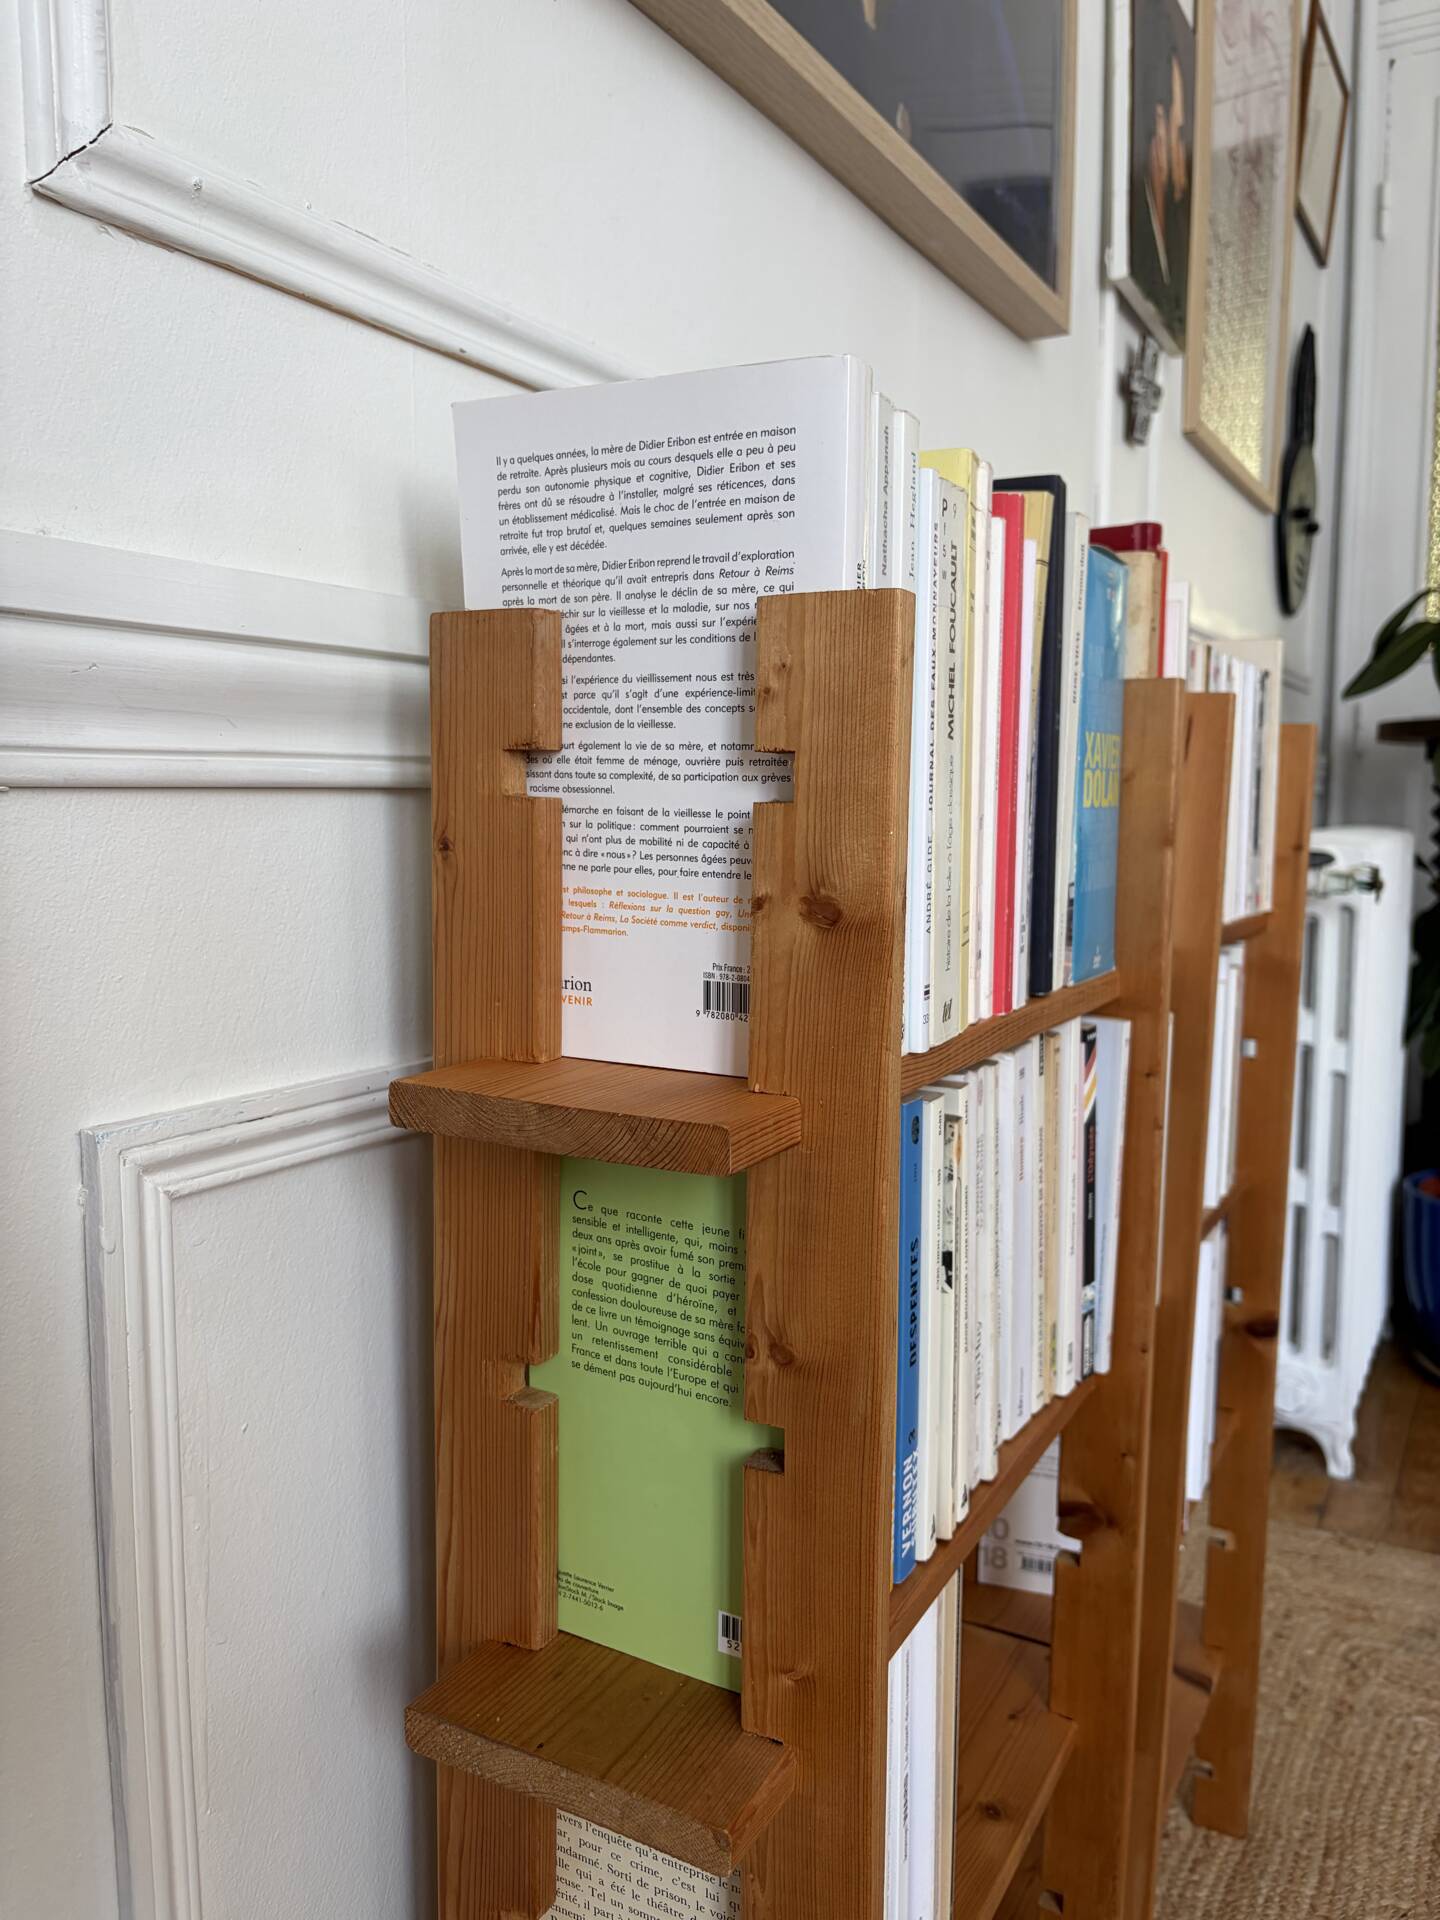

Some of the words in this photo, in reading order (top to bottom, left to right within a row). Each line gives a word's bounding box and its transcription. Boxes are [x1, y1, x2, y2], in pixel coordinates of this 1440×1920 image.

[495, 456, 501, 466] Il
[502, 458, 508, 467] y
[509, 457, 515, 465] a
[516, 452, 554, 466] quelques
[554, 448, 588, 460] années,
[590, 446, 599, 456] la
[600, 444, 623, 455] mère
[624, 441, 636, 452] de
[638, 439, 665, 451] Didier
[666, 435, 696, 448] Eribon
[697, 434, 712, 444] est
[712, 430, 744, 443] entrée
[744, 430, 758, 439] en
[760, 426, 796, 438] maison
[882, 425, 890, 495] Appanah
[497, 484, 521, 498] perdu
[525, 485, 540, 494] son
[544, 478, 590, 492] autonomie
[593, 475, 632, 489] physique
[635, 473, 644, 483] et
[648, 469, 691, 483] cognitive,
[696, 465, 724, 477] Didier
[729, 461, 760, 473] Eribon
[764, 460, 775, 470] et
[780, 460, 796, 469] ses
[499, 530, 528, 541] retraite
[531, 528, 542, 538] fut
[546, 529, 563, 539] trop
[566, 523, 591, 536] brutal
[594, 524, 604, 534] et,
[608, 521, 647, 534] quelques
[650, 517, 691, 529] semaines
[695, 512, 742, 525] seulement
[746, 509, 773, 523] après
[777, 510, 795, 519] son
[881, 500, 889, 576] Nathacha
[501, 580, 547, 594] personnelle
[550, 580, 559, 589] et
[562, 577, 601, 589] théorique
[604, 575, 622, 588] qu'il
[626, 574, 647, 584] avait
[650, 571, 688, 584] entrepris
[692, 569, 714, 580] dans
[718, 568, 750, 579] Retour
[753, 566, 760, 577] à
[764, 565, 794, 576] Reims
[949, 540, 958, 654] FOUCAULT
[948, 662, 956, 741] MICHEL
[526, 769, 552, 778] sissant
[553, 769, 573, 779] dans
[574, 770, 596, 779] toute
[597, 772, 607, 780] sa
[658, 770, 669, 781] de
[671, 773, 681, 781] sa
[741, 774, 758, 782] aux
[760, 772, 791, 784] grèves
[562, 976, 592, 992] rion
[571, 1215, 607, 1229] sensible
[612, 1223, 620, 1231] et
[625, 1223, 678, 1245] intelligente,
[684, 1237, 702, 1249] qui,
[708, 1242, 738, 1255] moins
[572, 1255, 601, 1272] l'école
[605, 1266, 626, 1277] pour
[630, 1272, 664, 1285] gagner
[668, 1276, 680, 1289] de
[685, 1283, 707, 1294] quoi
[712, 1289, 740, 1302] payer
[908, 1237, 919, 1367] DESPENTES
[571, 1331, 582, 1341] un
[592, 1336, 658, 1359] retentissement
[667, 1355, 732, 1377] considérable
[571, 1360, 580, 1369] se
[583, 1360, 616, 1378] dément
[618, 1372, 635, 1383] pas
[638, 1377, 692, 1397] aujourd'hui
[695, 1392, 731, 1407] encore.
[901, 1454, 913, 1558] VERNON
[578, 1837, 602, 1853] pour
[610, 1851, 621, 1862] ce
[629, 1860, 662, 1882] crime,
[671, 1876, 696, 1893] c'est
[705, 1887, 719, 1903] lui
[585, 1821, 632, 1850] l'enquête
[634, 1839, 658, 1861] qu'a
[661, 1858, 715, 1884] entreprise
[606, 1863, 632, 1883] Sorti
[636, 1876, 649, 1890] de
[653, 1886, 690, 1909] prison,
[695, 1900, 705, 1914] le
